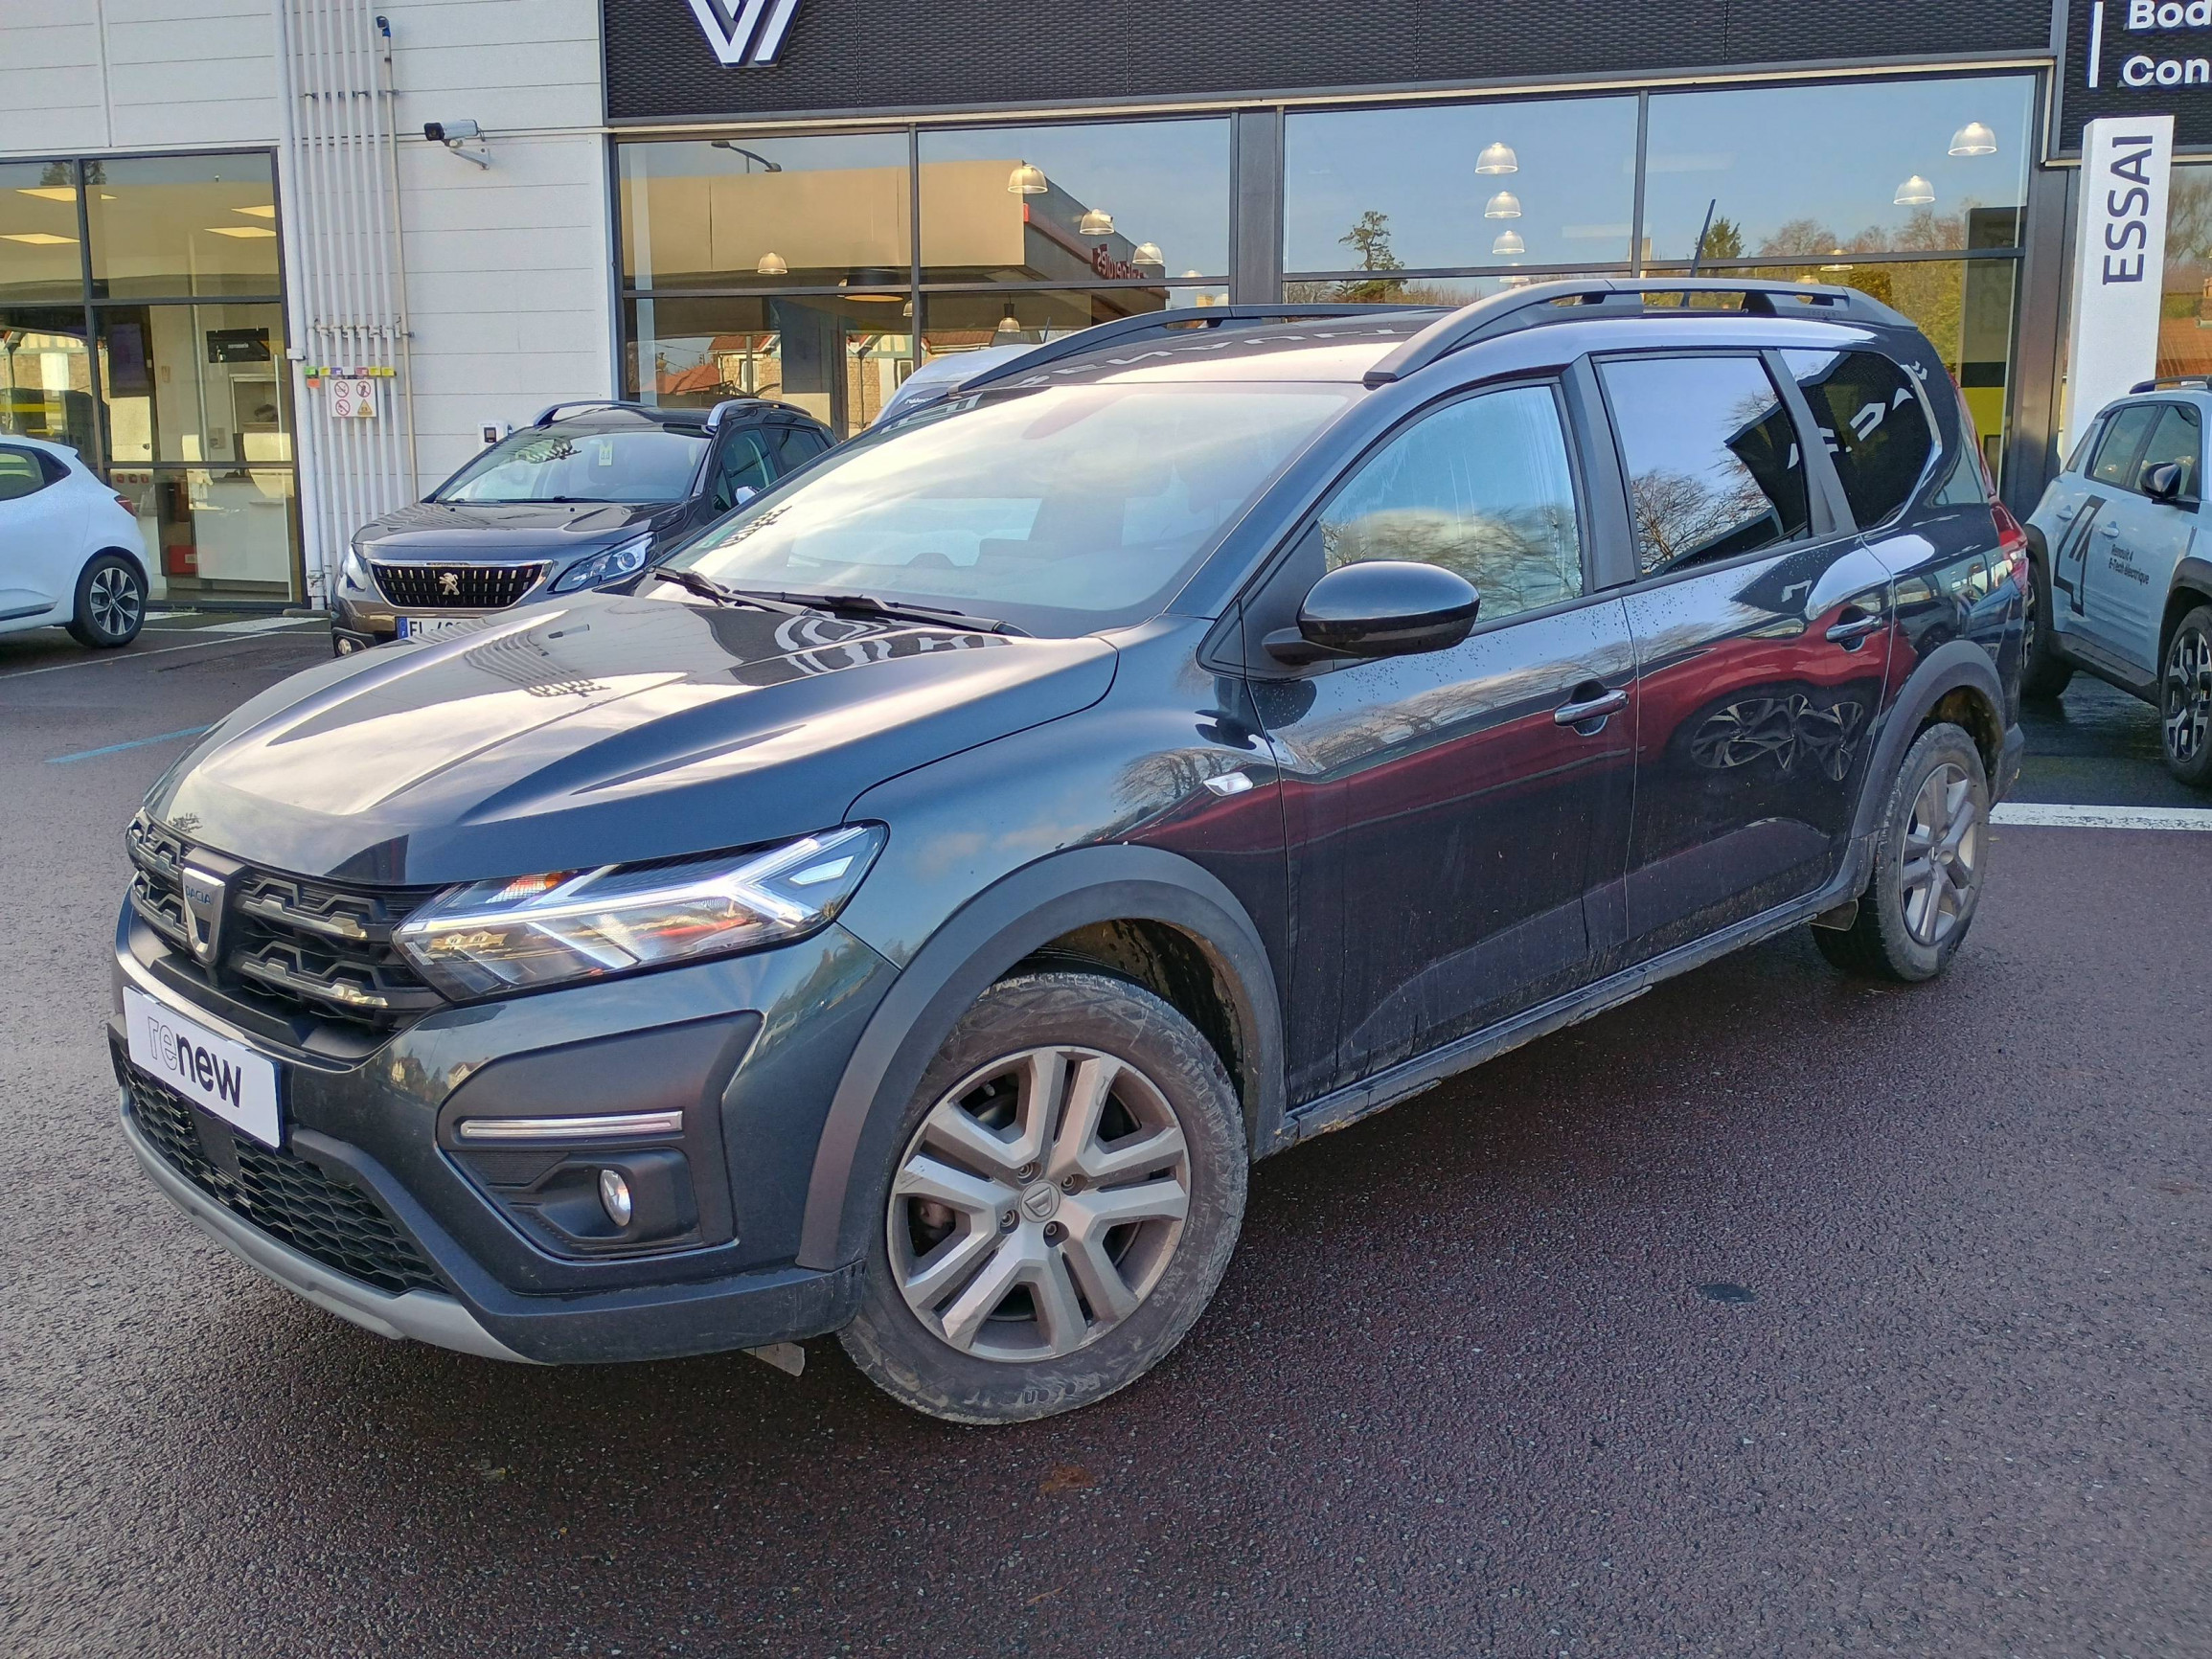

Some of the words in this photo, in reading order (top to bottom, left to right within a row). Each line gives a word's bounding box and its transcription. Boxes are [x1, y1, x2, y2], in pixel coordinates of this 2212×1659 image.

[2129, 0, 2212, 30] Bod
[2123, 56, 2210, 86] Con
[2103, 135, 2153, 285] ESSAI
[186, 883, 212, 904] DACIA
[148, 1016, 241, 1109] renew
